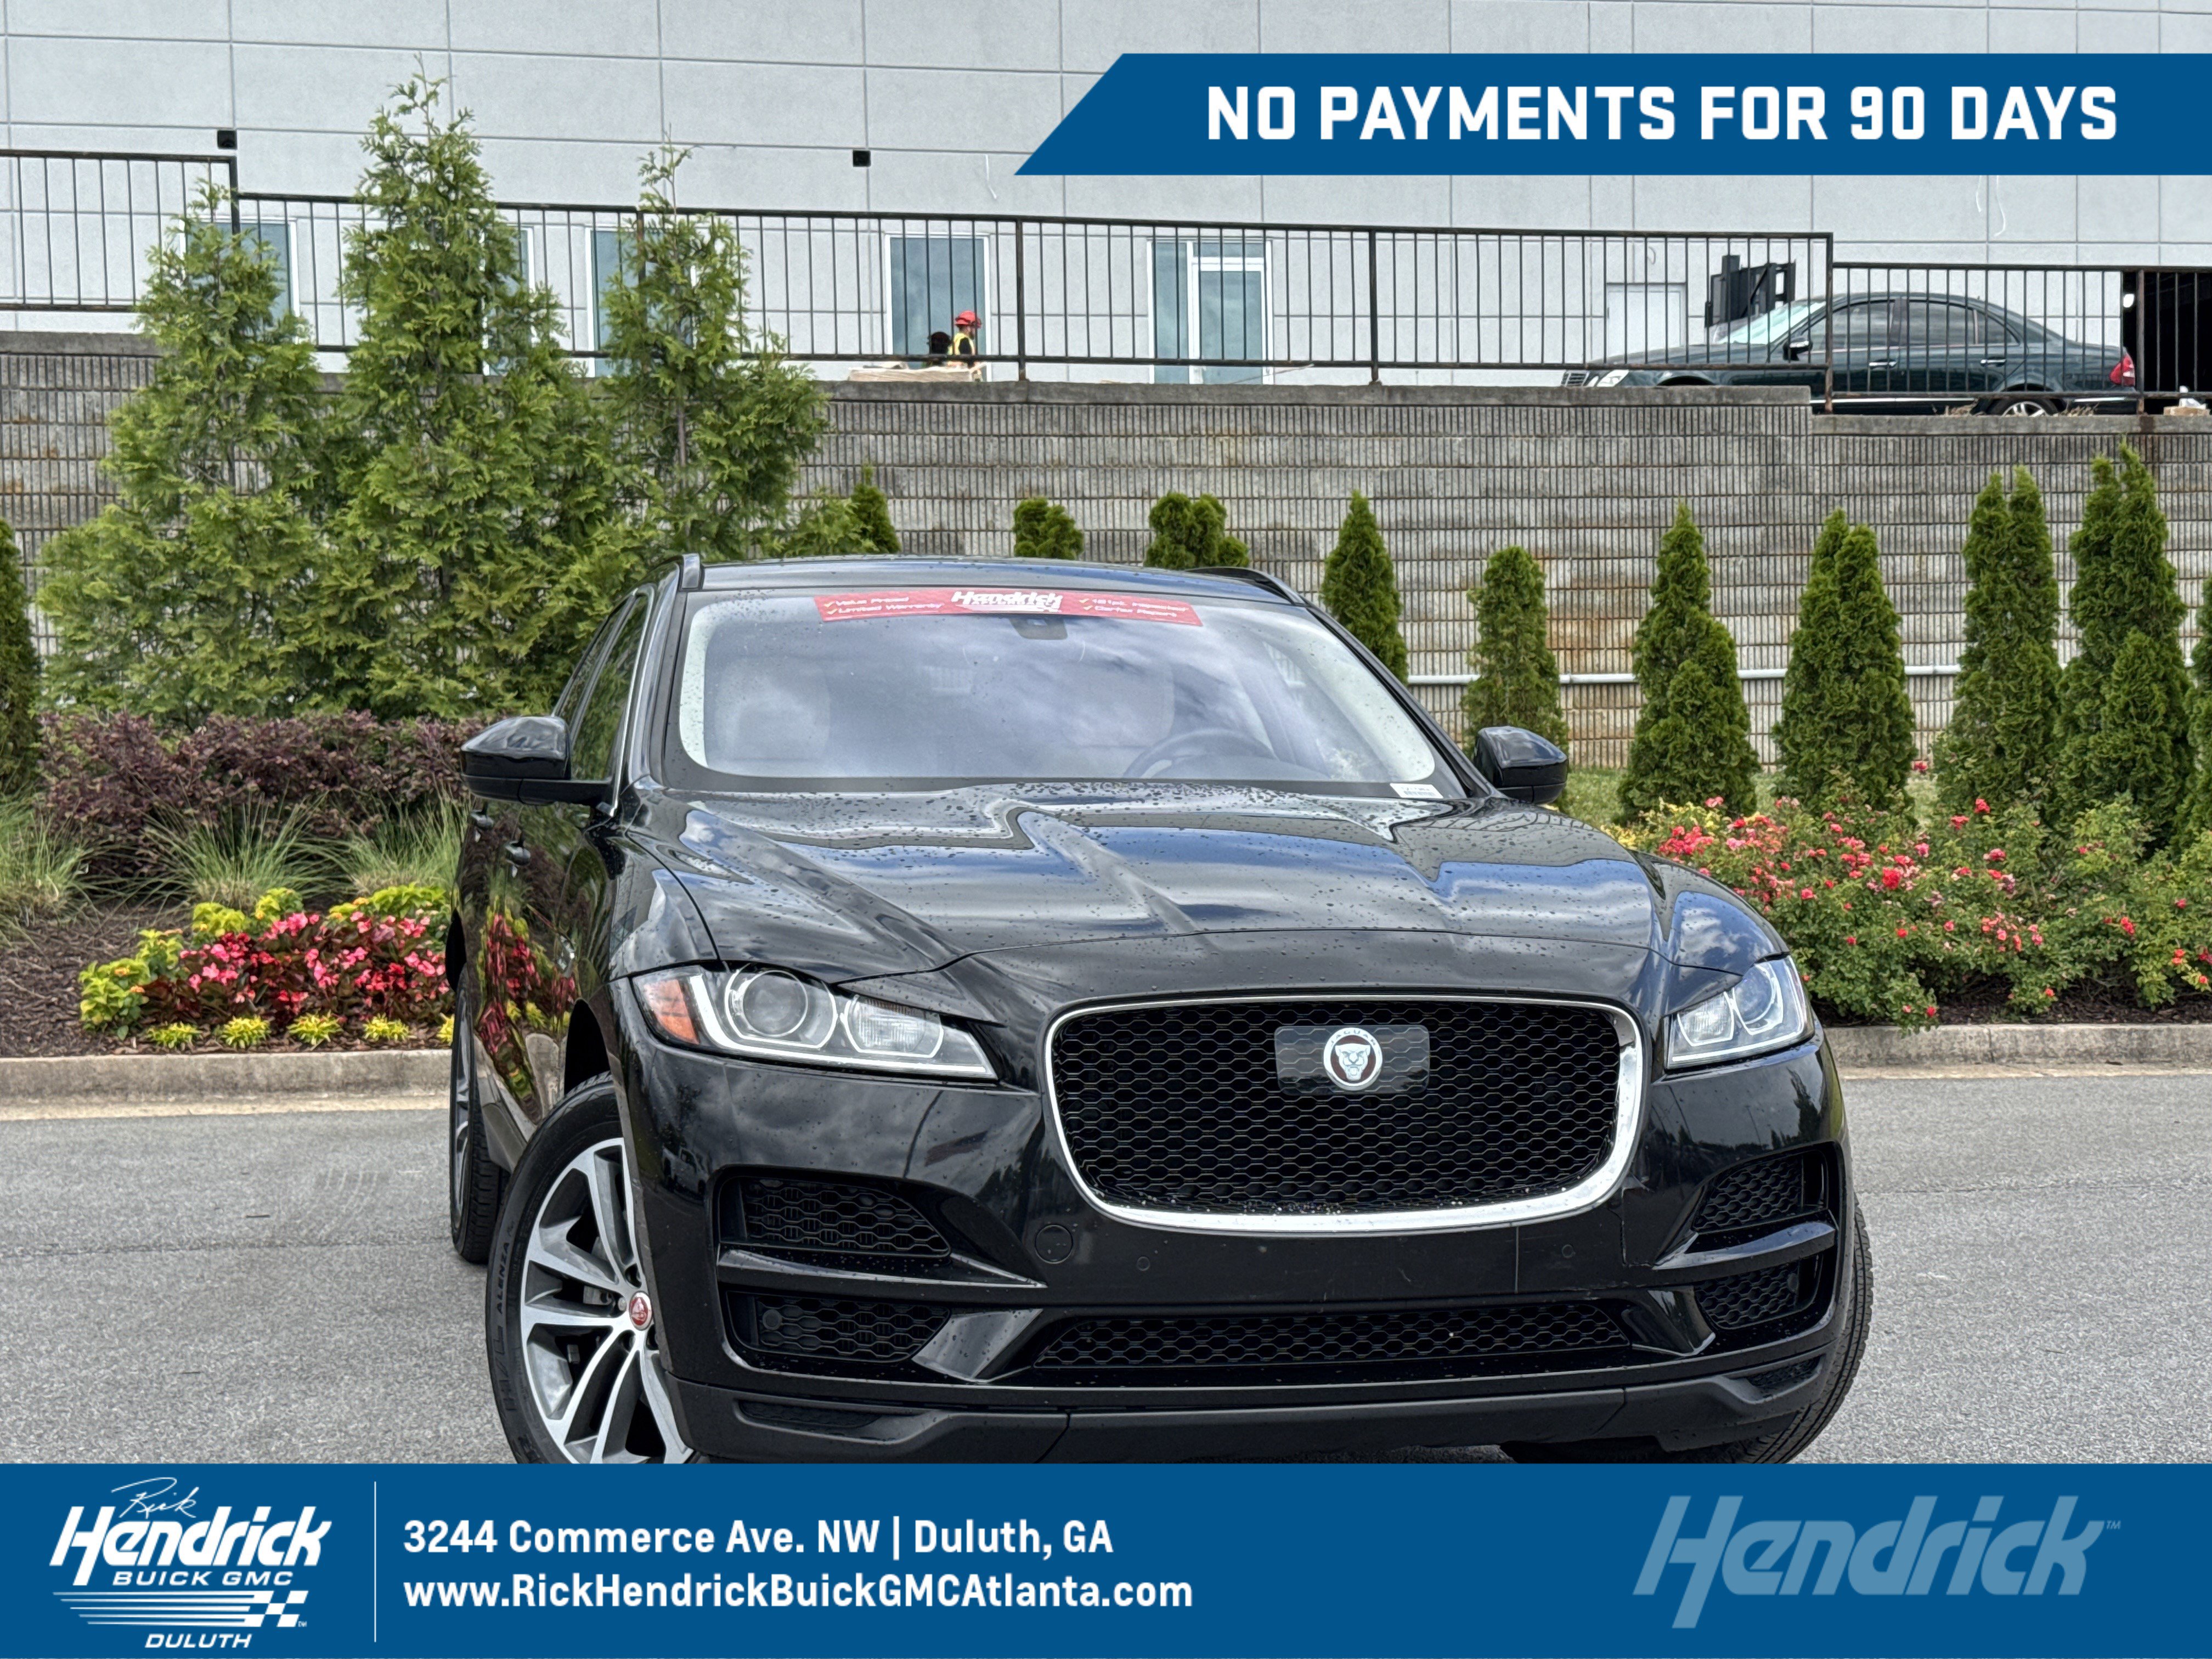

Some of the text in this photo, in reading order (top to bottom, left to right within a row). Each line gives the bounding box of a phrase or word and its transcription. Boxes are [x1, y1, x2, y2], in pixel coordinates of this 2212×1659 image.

[951, 591, 1063, 610] Hendrick
[1330, 1029, 1376, 1046] JAGUAR
[496, 1242, 509, 1316] ALENZA
